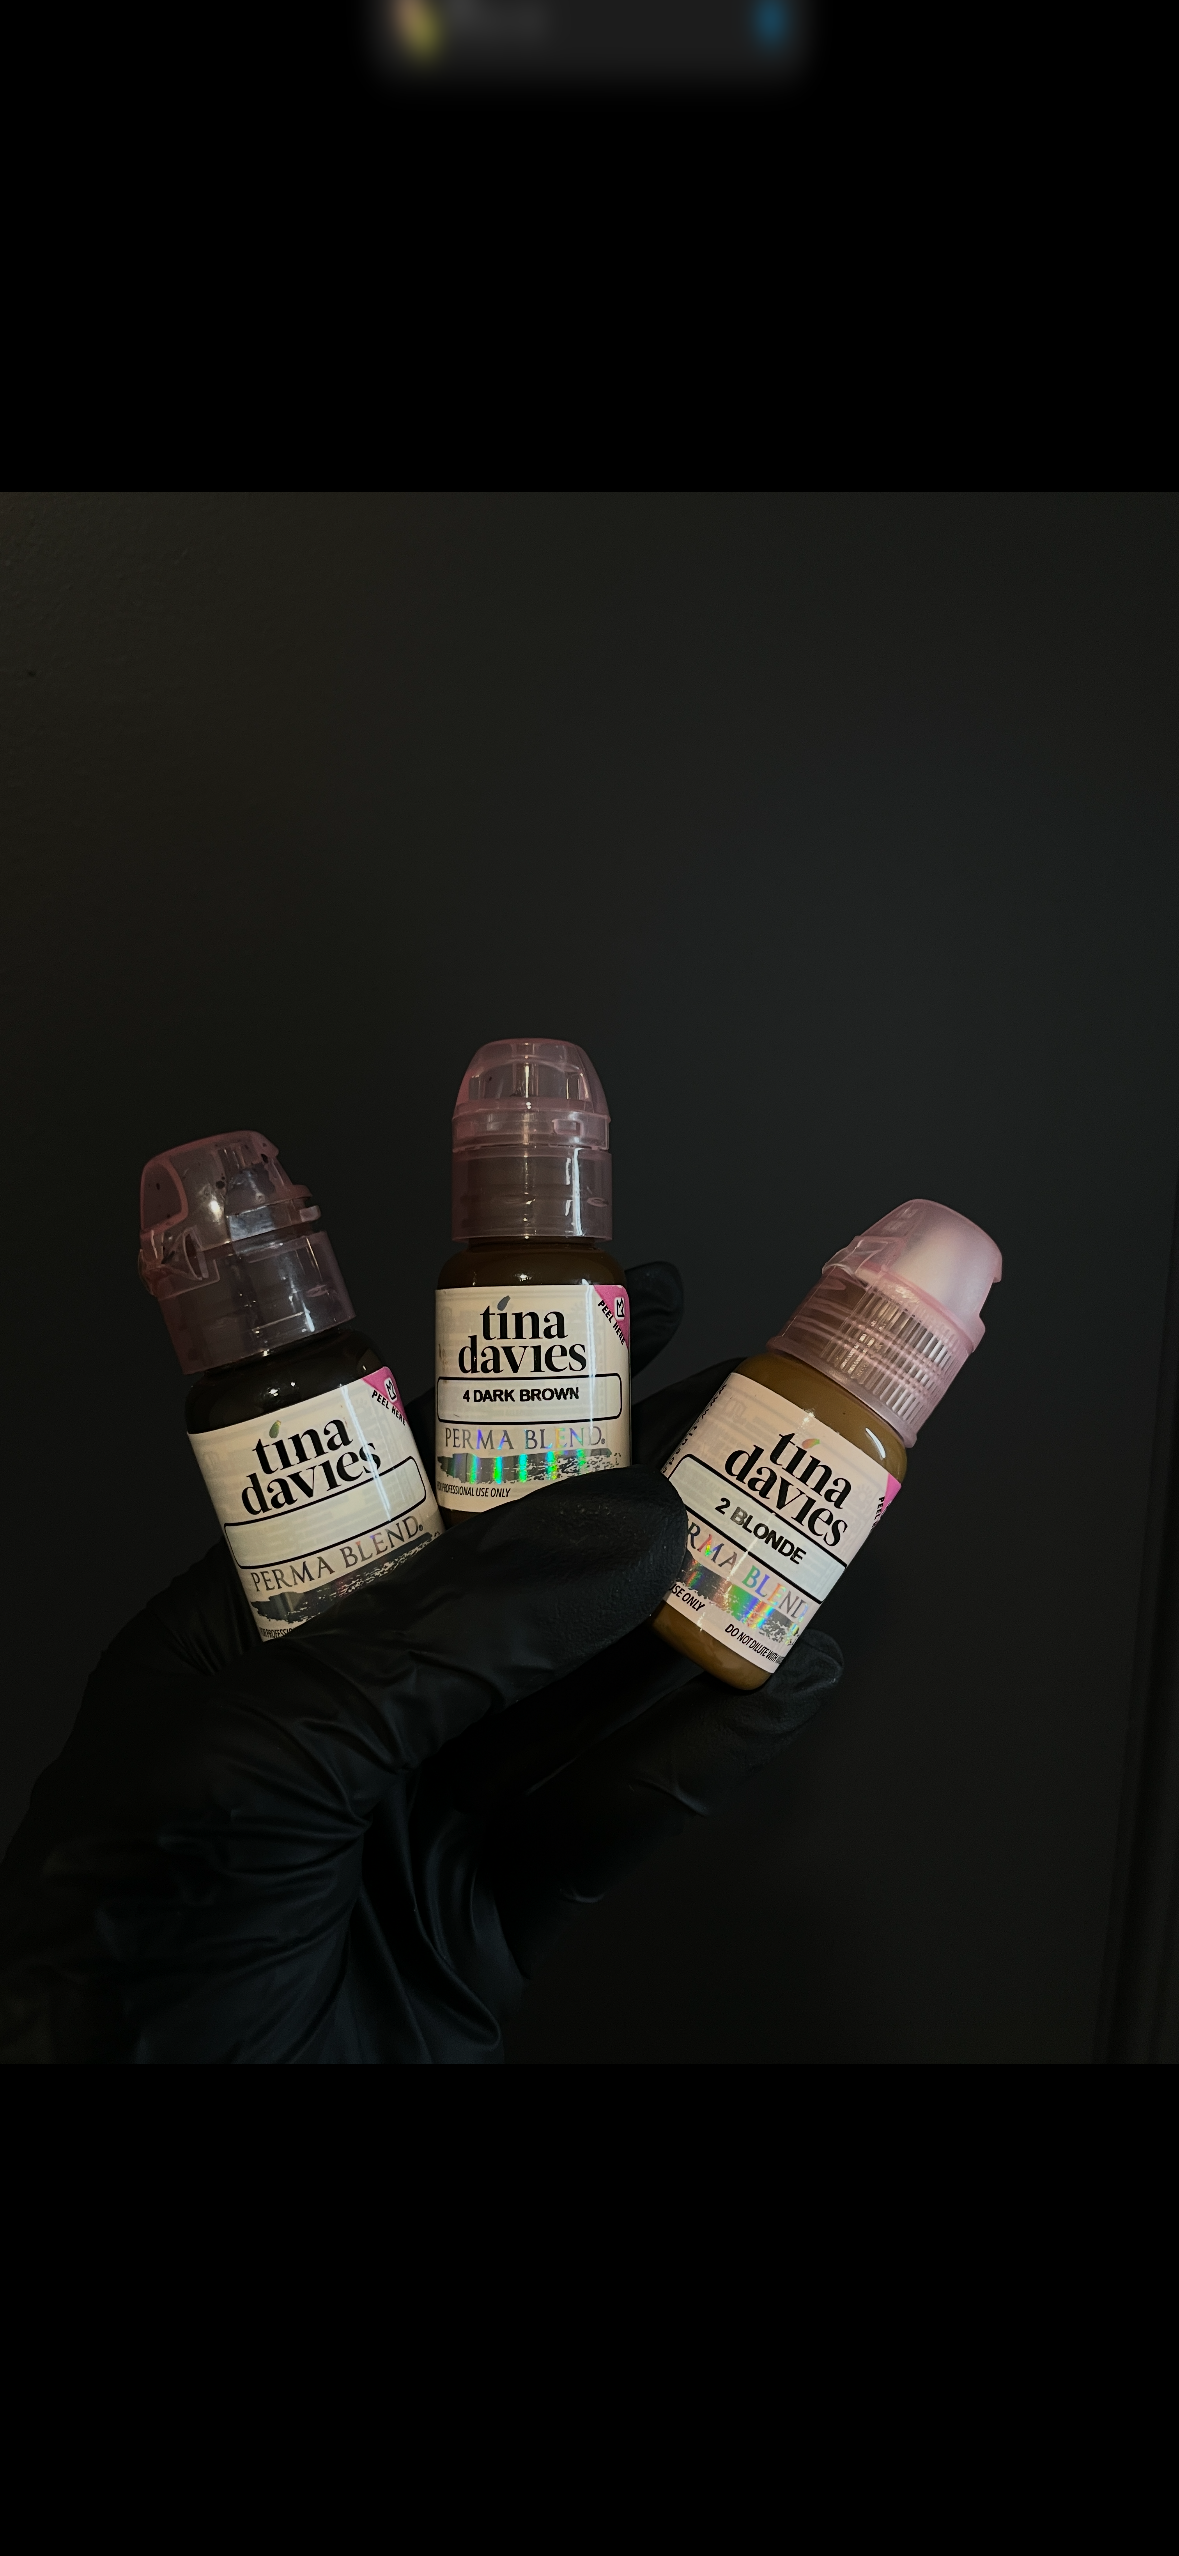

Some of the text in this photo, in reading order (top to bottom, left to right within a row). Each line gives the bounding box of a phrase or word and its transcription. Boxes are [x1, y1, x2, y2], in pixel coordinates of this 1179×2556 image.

[480, 1295, 568, 1340] tina
[598, 1300, 626, 1346] PEEL HERE
[458, 1335, 587, 1374] davies
[372, 1390, 389, 1409] PEEL
[463, 1387, 579, 1403] 4 DARK BROWN
[252, 1418, 353, 1475] tina
[445, 1428, 514, 1450] PERMA
[241, 1441, 382, 1516] davies
[770, 1432, 852, 1510] tina
[476, 1487, 489, 1497] USE
[490, 1488, 511, 1498] ONLY
[725, 1444, 849, 1547] davies
[687, 1521, 738, 1568] RMA
[715, 1497, 807, 1565] 2 BLONDE
[250, 1556, 335, 1592] PERMA
[682, 1592, 706, 1612] ONLY
[725, 1623, 739, 1636] DO
[737, 1632, 753, 1645] NOT
[749, 1640, 769, 1658] DILUTE
